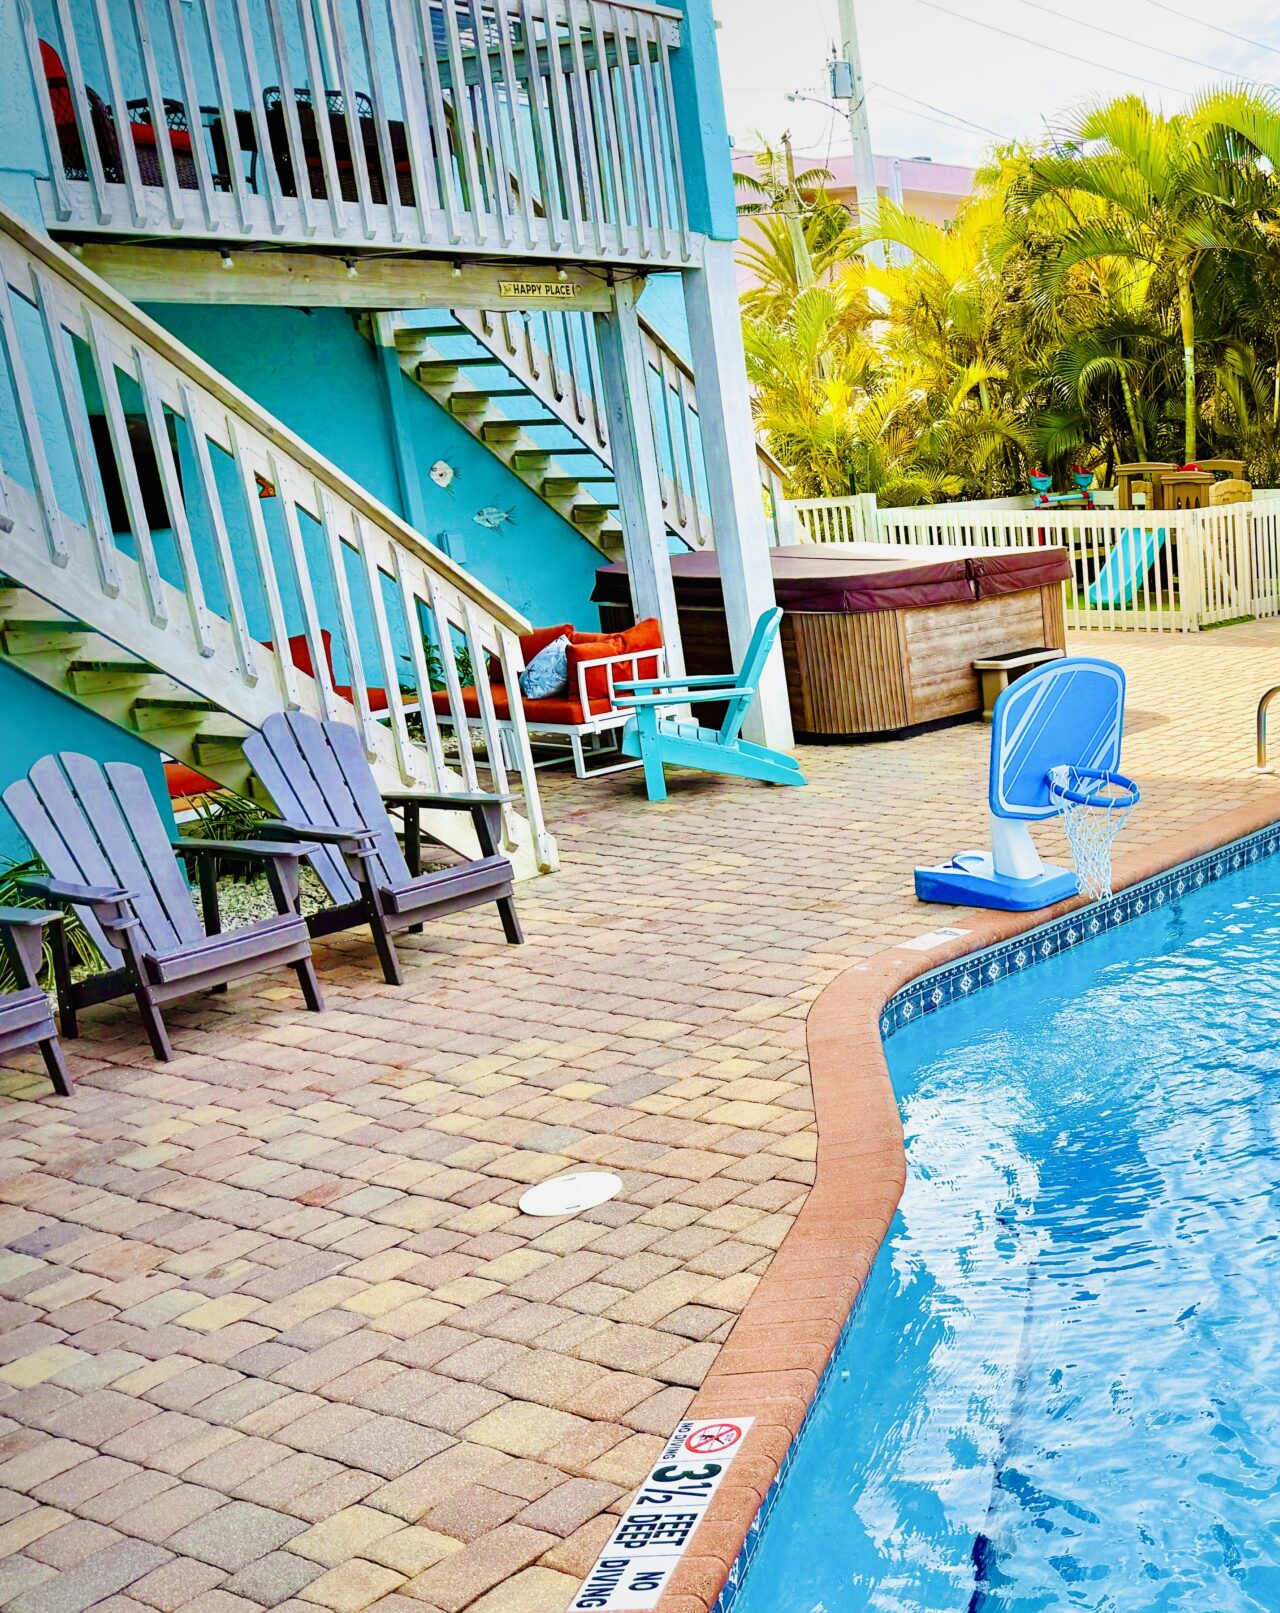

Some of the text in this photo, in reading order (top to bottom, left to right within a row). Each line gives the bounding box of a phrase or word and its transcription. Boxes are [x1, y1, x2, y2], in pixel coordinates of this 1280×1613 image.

[514, 284, 571, 295] HAPPY PLACE
[662, 1422, 694, 1460] NO DIVING
[613, 1513, 662, 1548] DEEP
[649, 1513, 698, 1546] FEET
[576, 1559, 631, 1608] DIVING
[628, 1571, 665, 1591] NO
